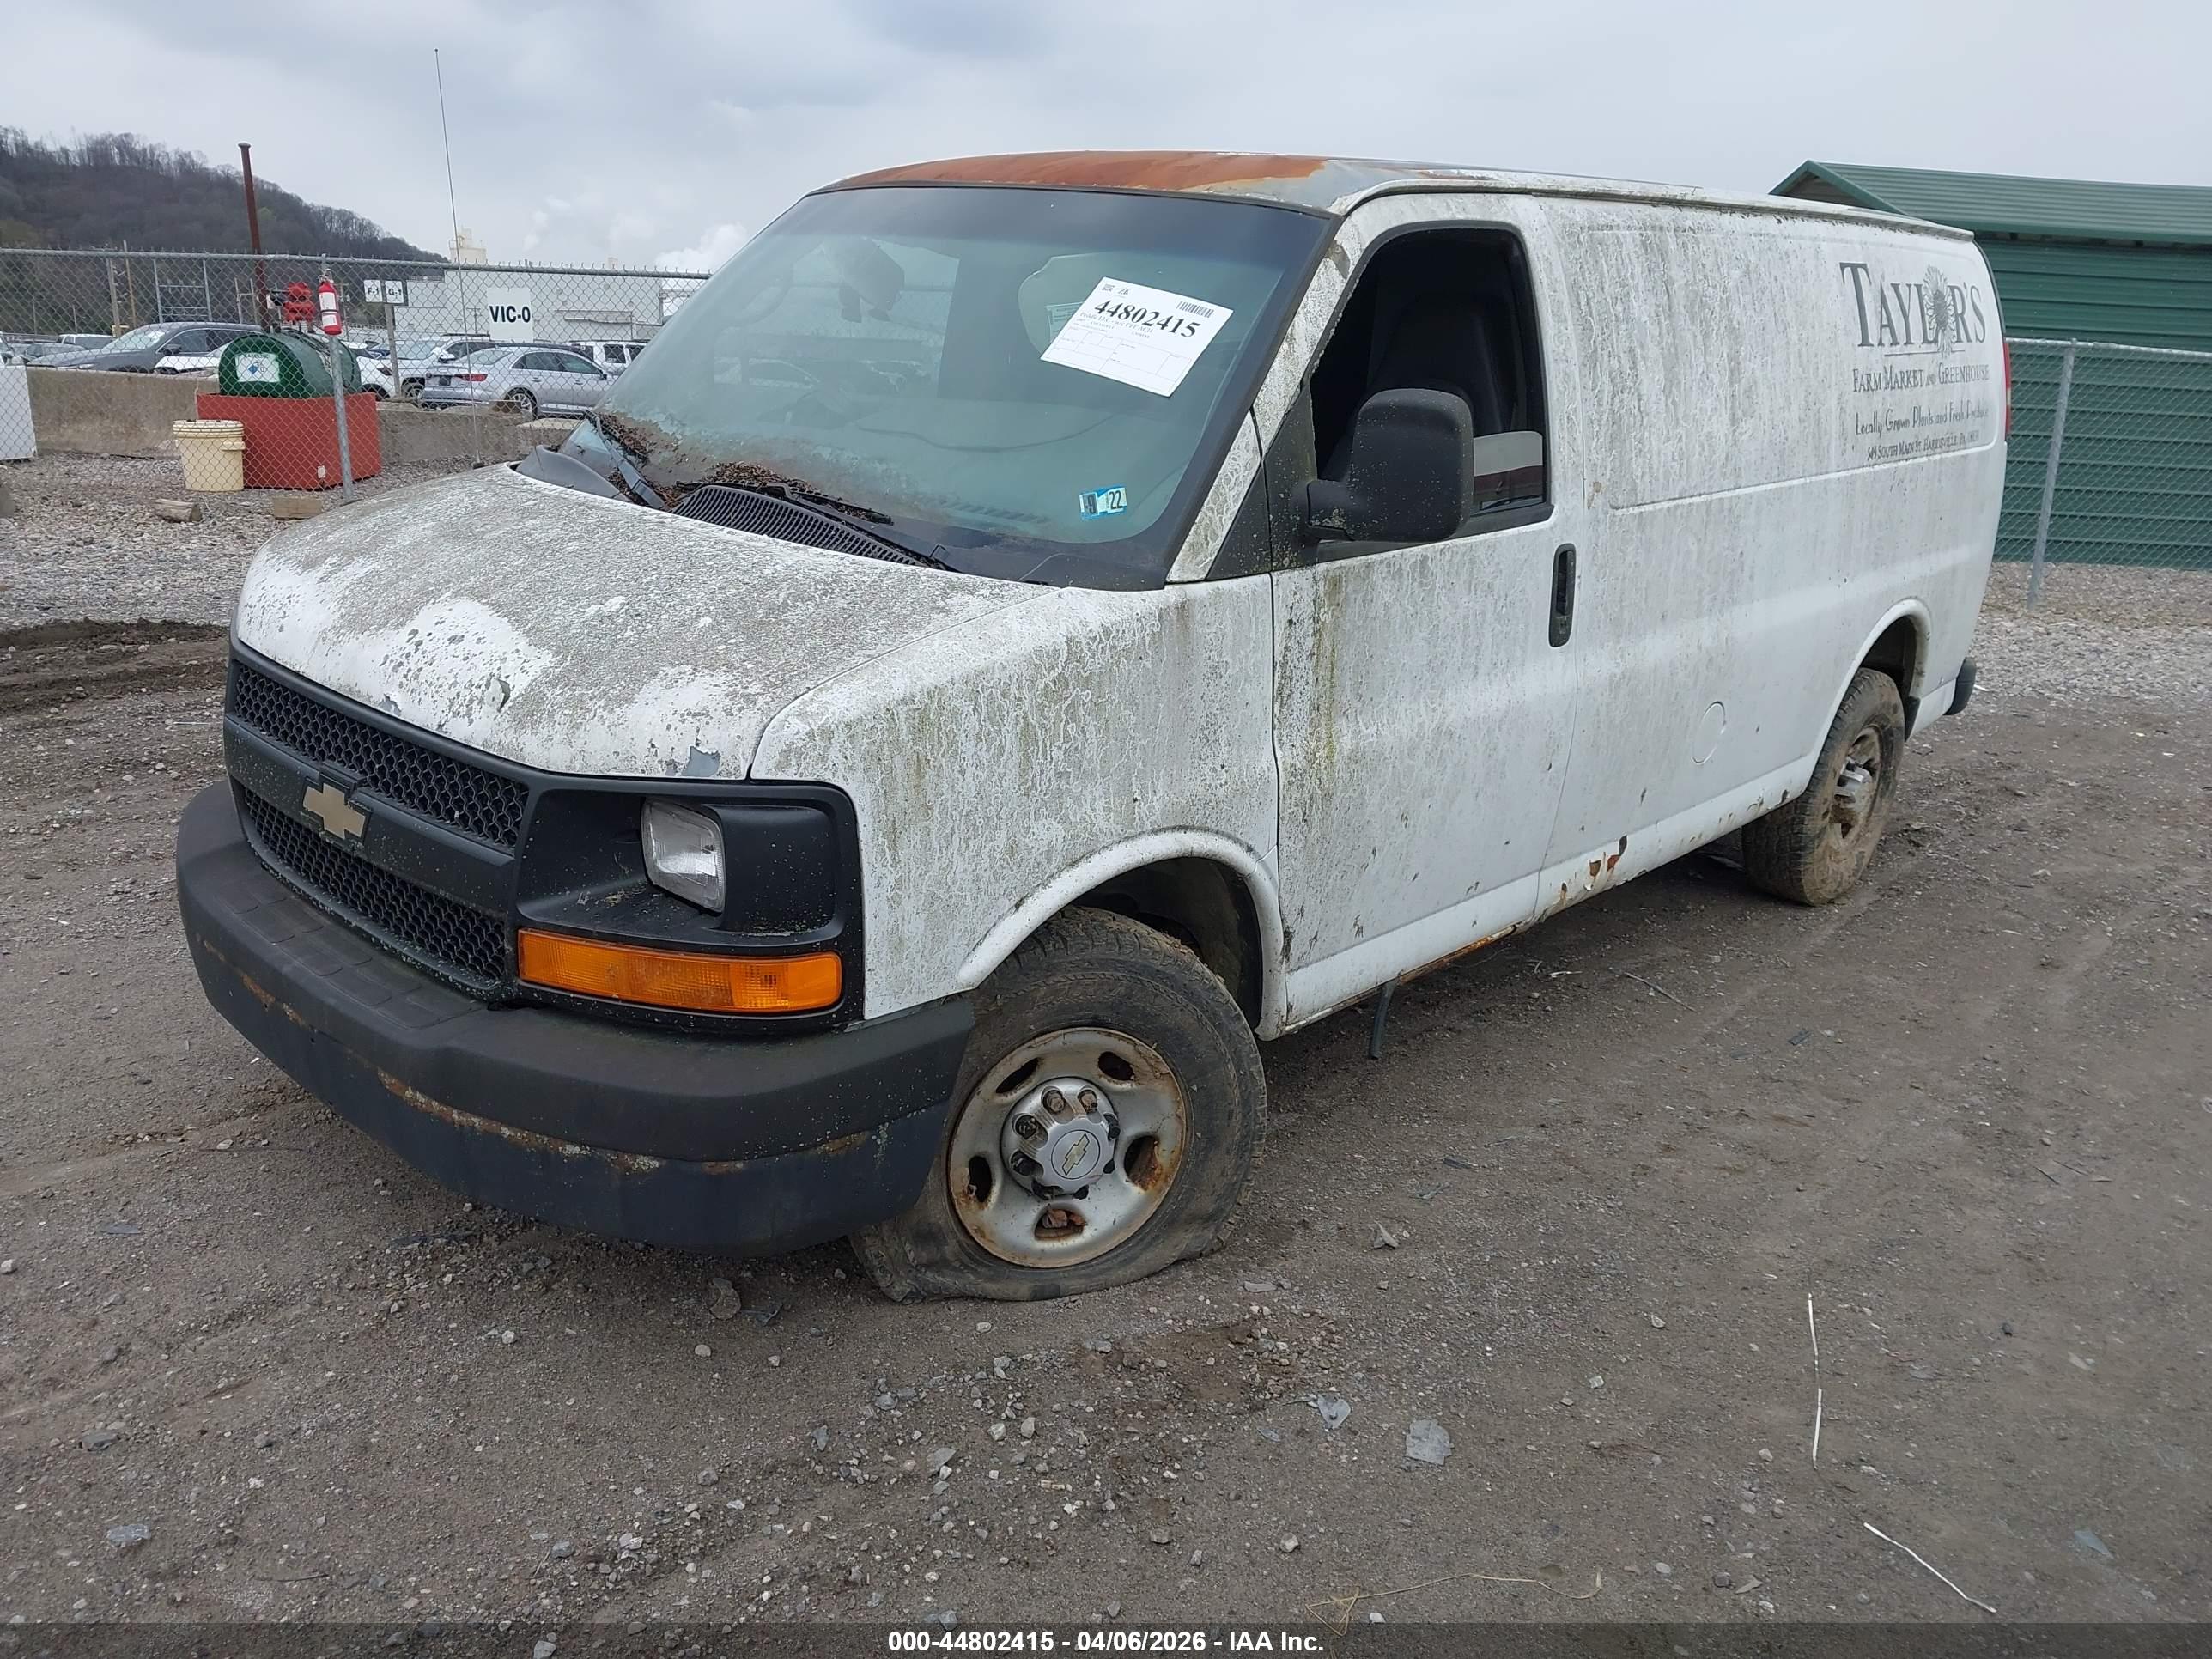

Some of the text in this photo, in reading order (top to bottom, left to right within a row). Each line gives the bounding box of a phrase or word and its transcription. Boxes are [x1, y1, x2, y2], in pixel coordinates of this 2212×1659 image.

[388, 288, 402, 296] G-1
[1839, 261, 1986, 348] TAYLR'S
[1093, 300, 1201, 337] 44802415
[1852, 368, 1881, 392] FARM
[1883, 365, 1923, 391] MARKET
[1938, 362, 1990, 385] GREENHOUSE
[1855, 410, 1882, 439] Locally
[1885, 408, 1911, 431] Grown
[1912, 405, 1934, 428] Plants
[1109, 490, 1122, 510] 22
